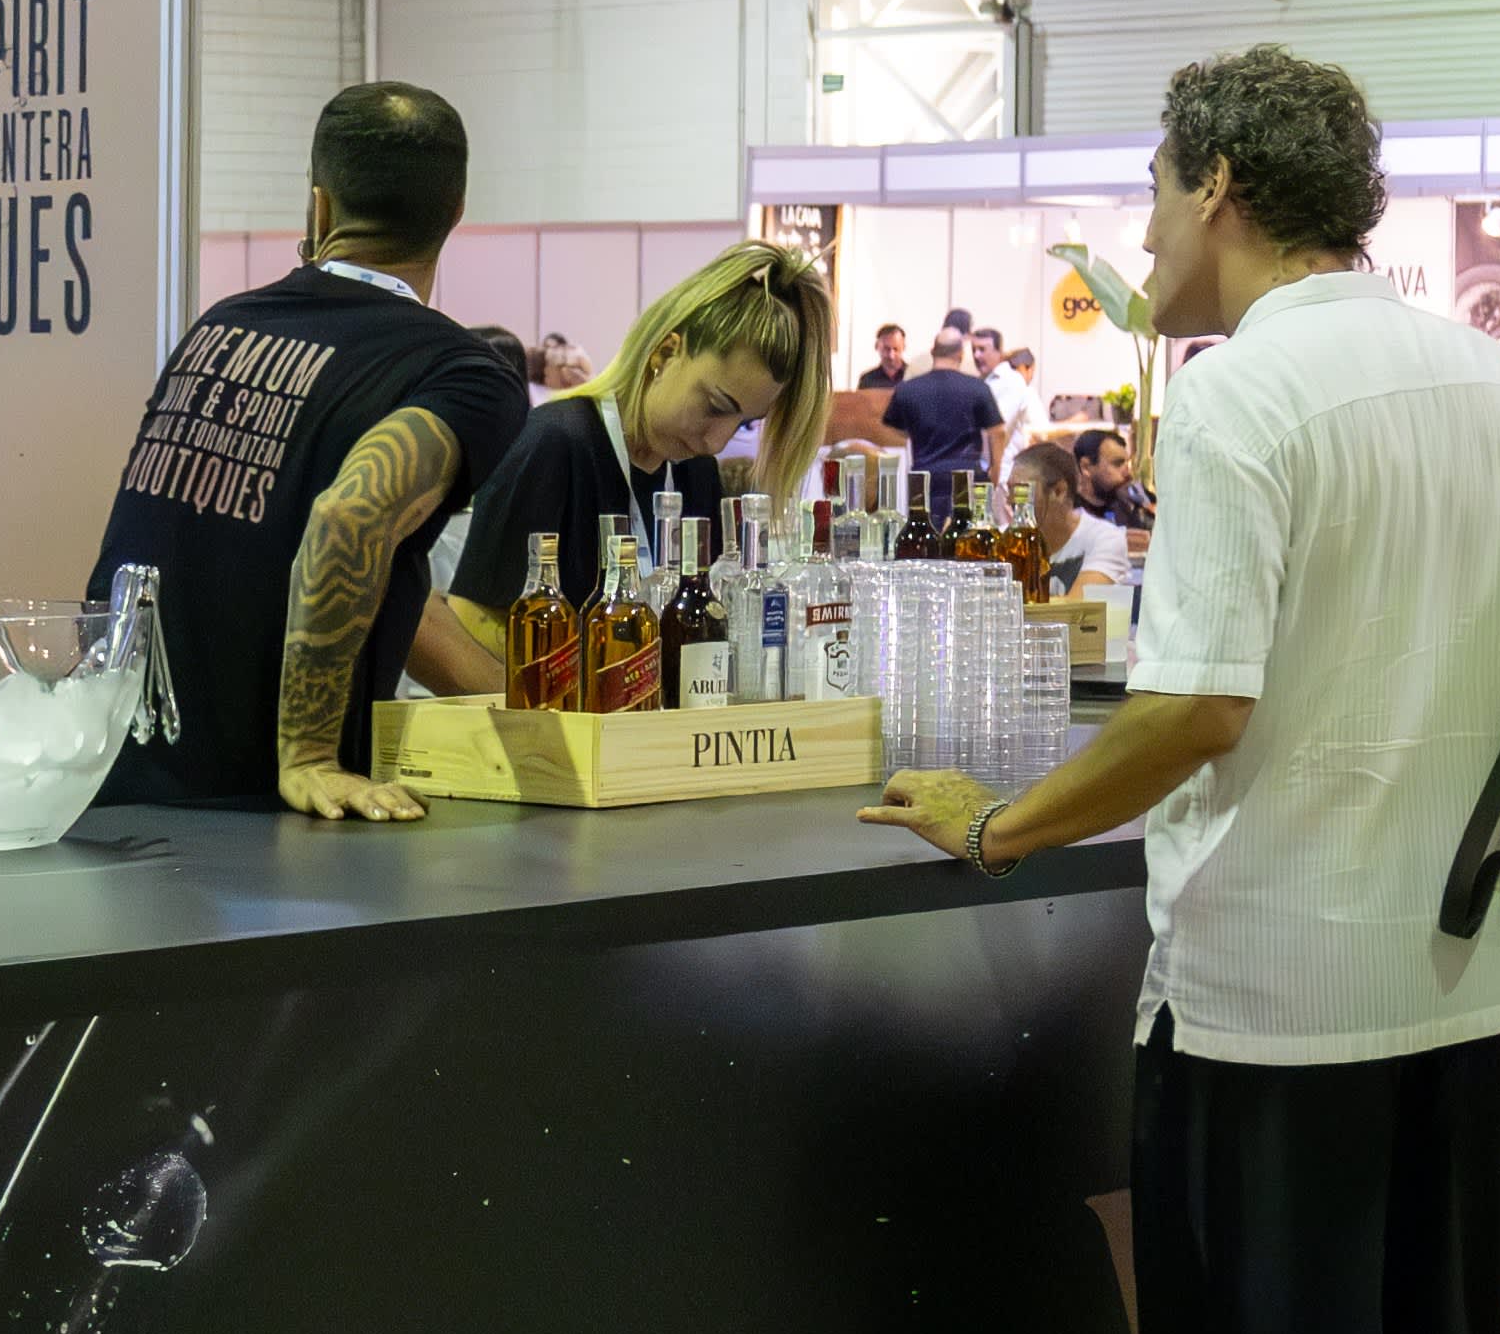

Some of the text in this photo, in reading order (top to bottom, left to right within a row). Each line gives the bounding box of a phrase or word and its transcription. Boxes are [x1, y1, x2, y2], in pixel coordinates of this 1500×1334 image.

[173, 325, 335, 396] PREMIUM
[200, 381, 225, 418] &
[228, 389, 304, 438] SPIRIT
[185, 419, 287, 470] FORMENTERA
[692, 727, 797, 768] PINTIA
